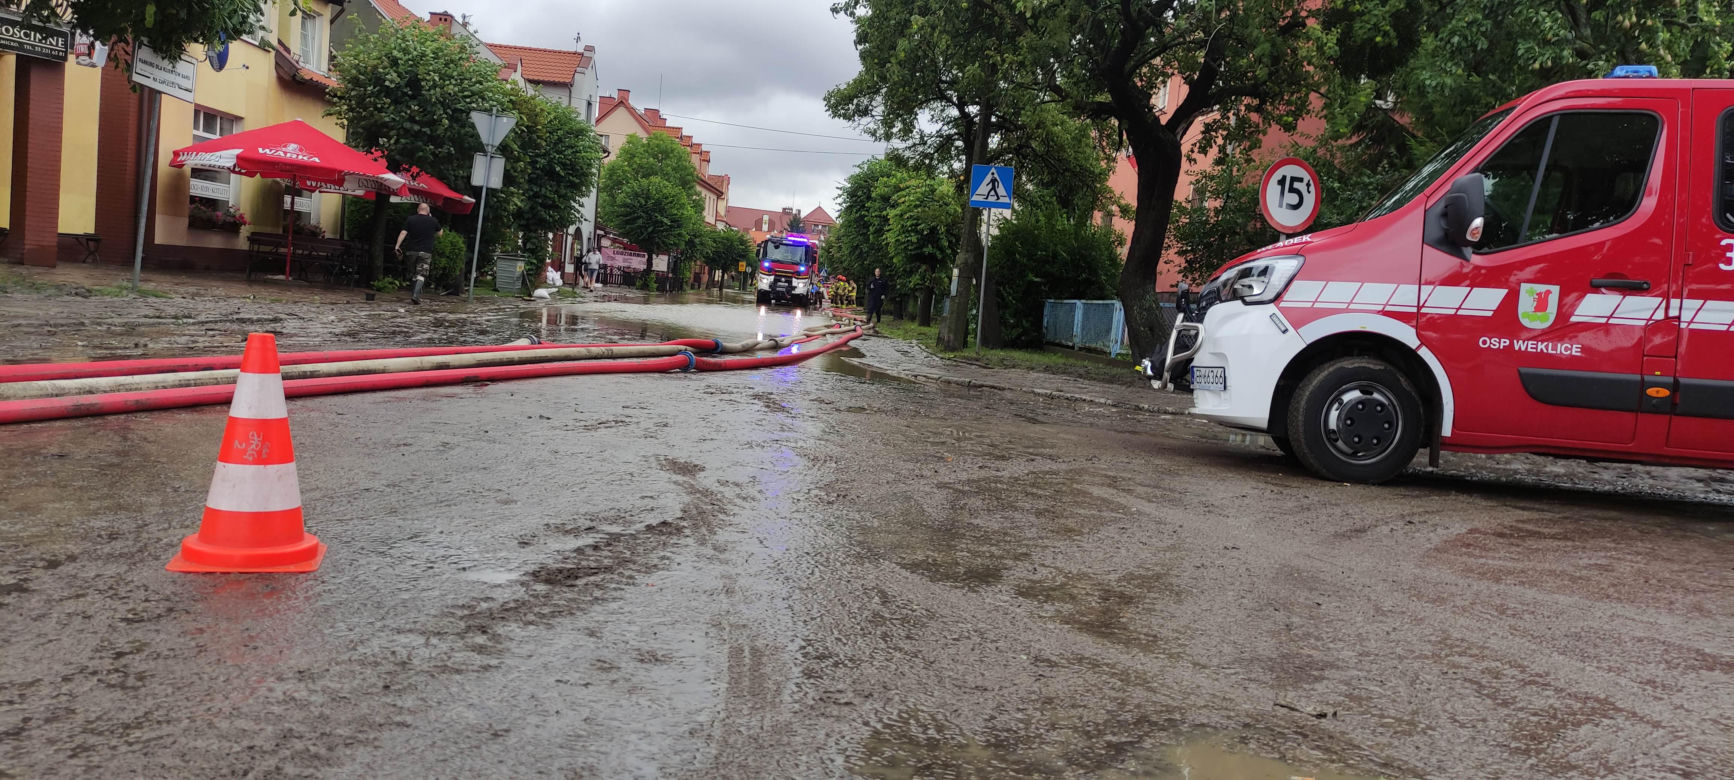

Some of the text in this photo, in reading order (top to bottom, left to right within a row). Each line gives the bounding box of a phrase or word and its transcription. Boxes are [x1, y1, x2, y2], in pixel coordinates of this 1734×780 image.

[257, 147, 321, 163] WARKA
[1478, 337, 1582, 356] OSP WEKLICE
